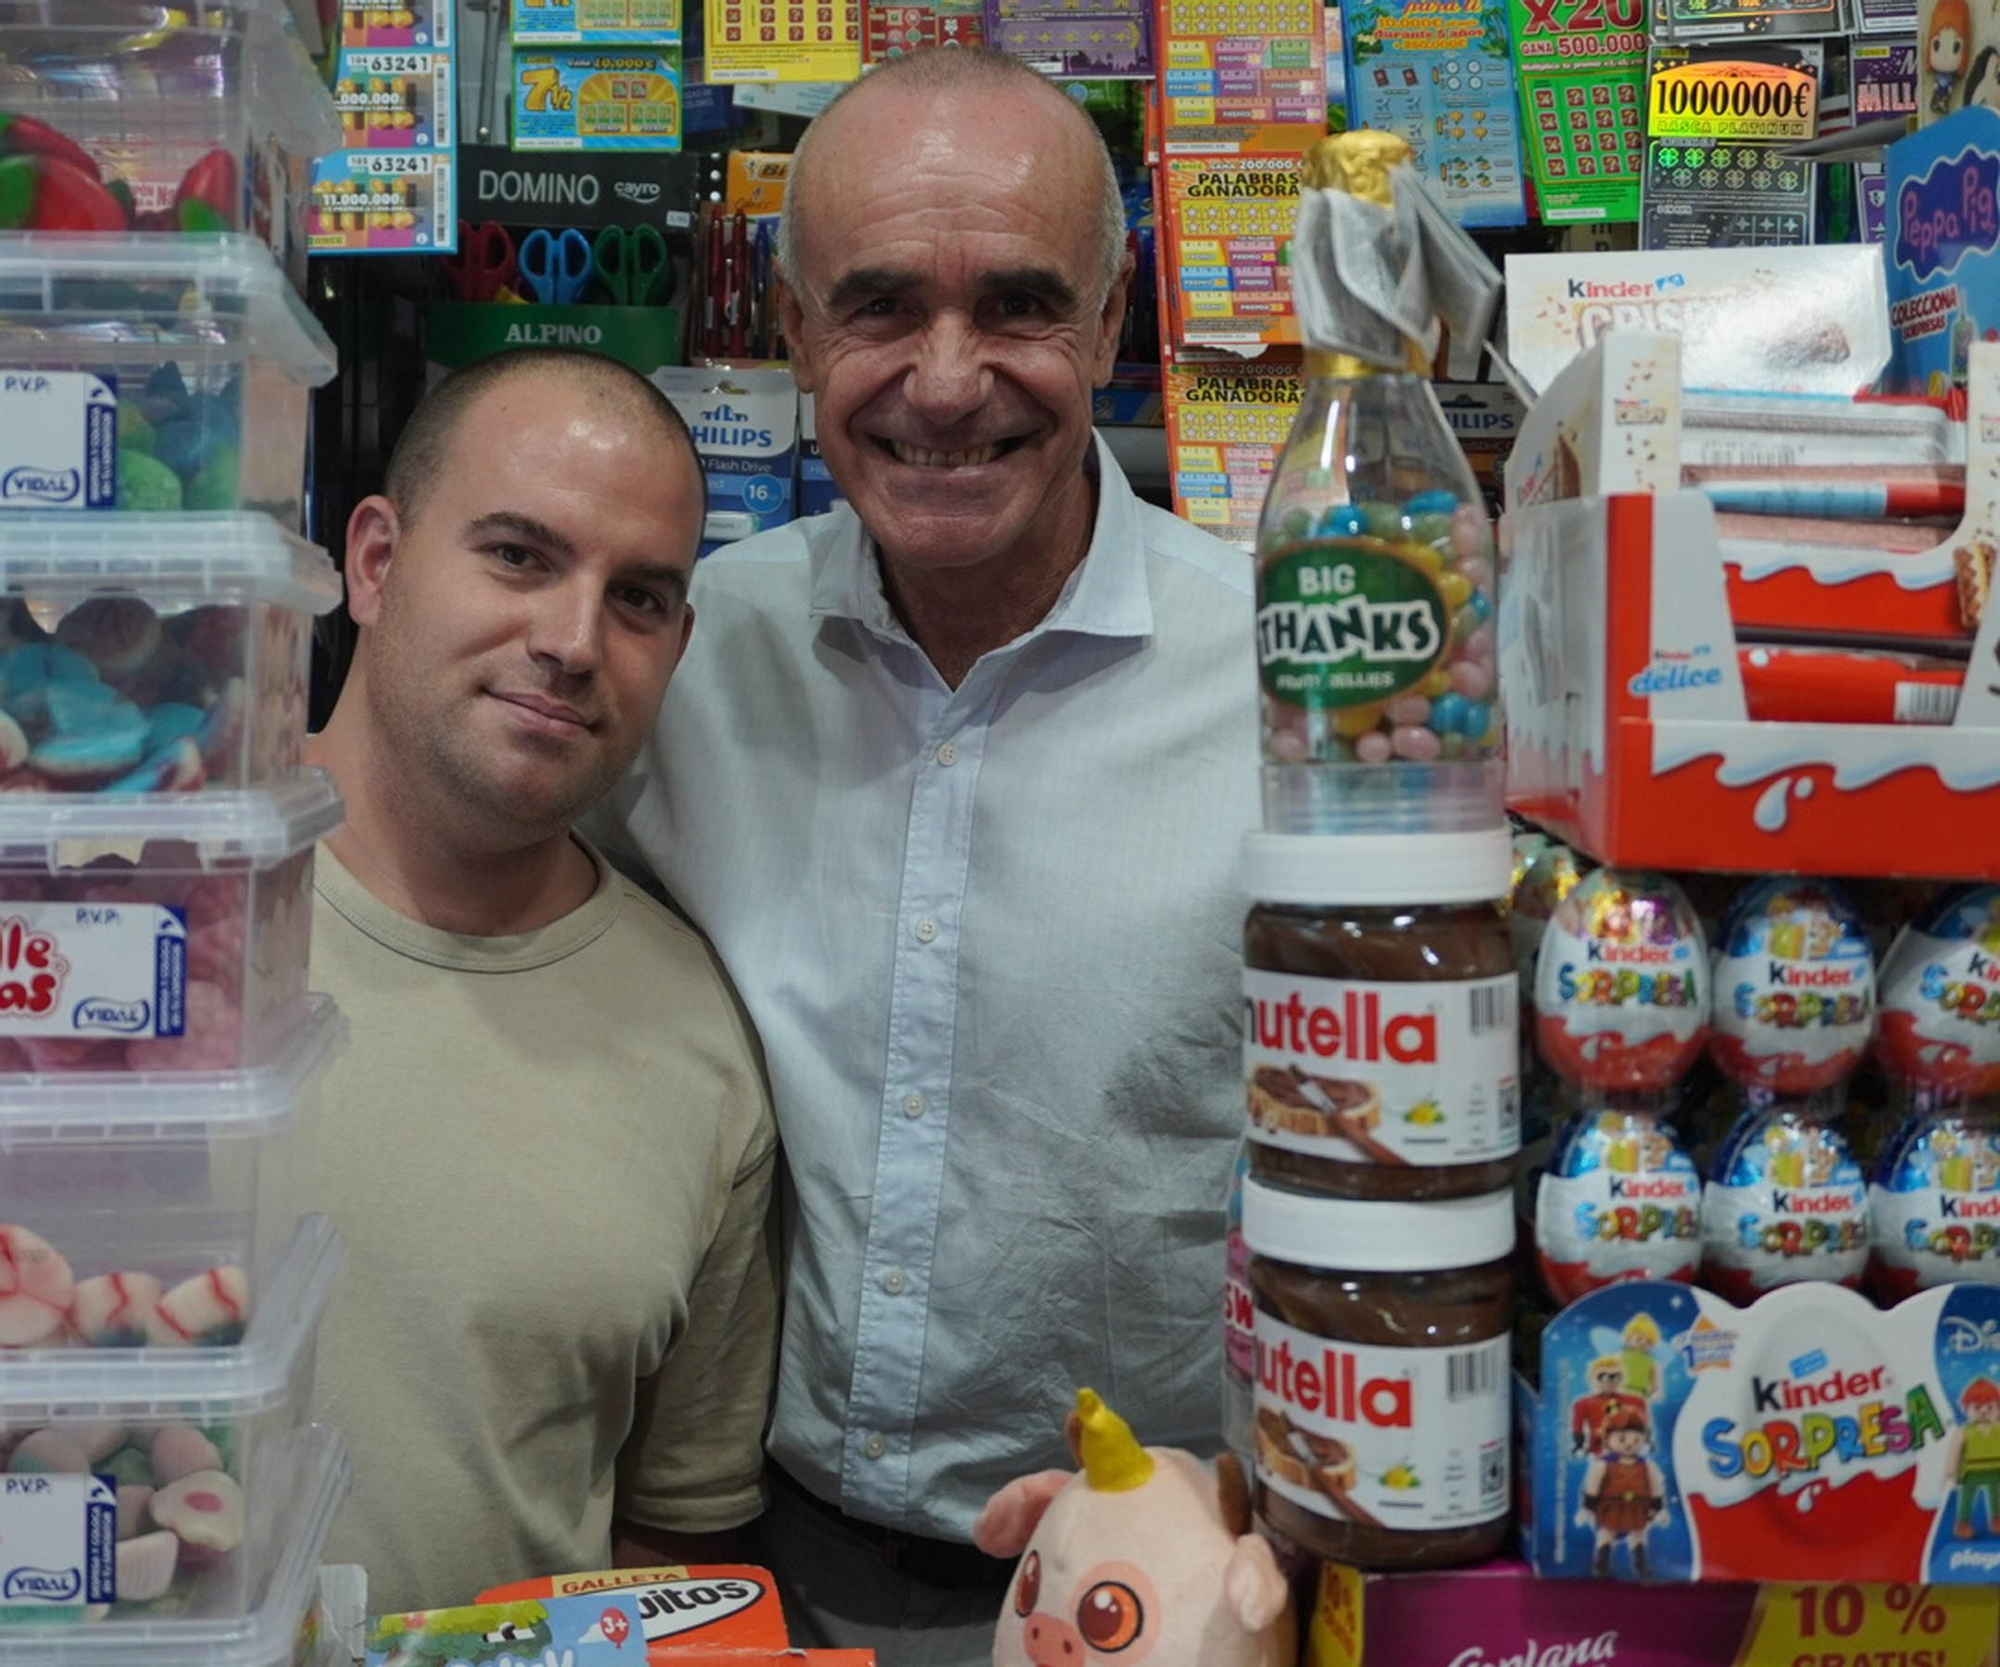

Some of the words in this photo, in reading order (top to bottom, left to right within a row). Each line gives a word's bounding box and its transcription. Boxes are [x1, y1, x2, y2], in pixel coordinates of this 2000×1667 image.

[1521, 42, 1553, 54] GANA
[371, 56, 428, 71] 63241
[521, 68, 560, 112] 7
[1657, 120, 1712, 134] RASCA
[1718, 120, 1805, 136] PLATINUM
[372, 157, 429, 172] 63241
[1239, 160, 1293, 170] 200.000
[1197, 172, 1301, 185] PALABRAS
[478, 169, 600, 206] DOMINO
[614, 179, 661, 199] cayro
[1187, 185, 1301, 198] GANADORA
[1891, 287, 1958, 329] COLECCIONA
[504, 322, 603, 344] ALPINO
[1196, 378, 1301, 392] PALABRAS
[1452, 413, 1514, 429] ILIPS
[693, 426, 773, 447] HILIPS
[708, 459, 740, 471] Flash
[741, 462, 772, 474] Drive
[13, 476, 69, 492] VIDAL
[748, 485, 768, 500] 16
[1298, 564, 1356, 596] BIG
[1260, 601, 1434, 657] THANKS
[84, 1007, 139, 1023] VIDAL
[1257, 1340, 1414, 1429] utella
[1702, 1383, 1946, 1479] SORPRESA
[14, 1576, 70, 1591] VIDAL
[561, 1572, 681, 1594] GALLETA
[1792, 1584, 1865, 1638] 10
[1883, 1583, 1947, 1635] %
[602, 1616, 628, 1634] 3+
